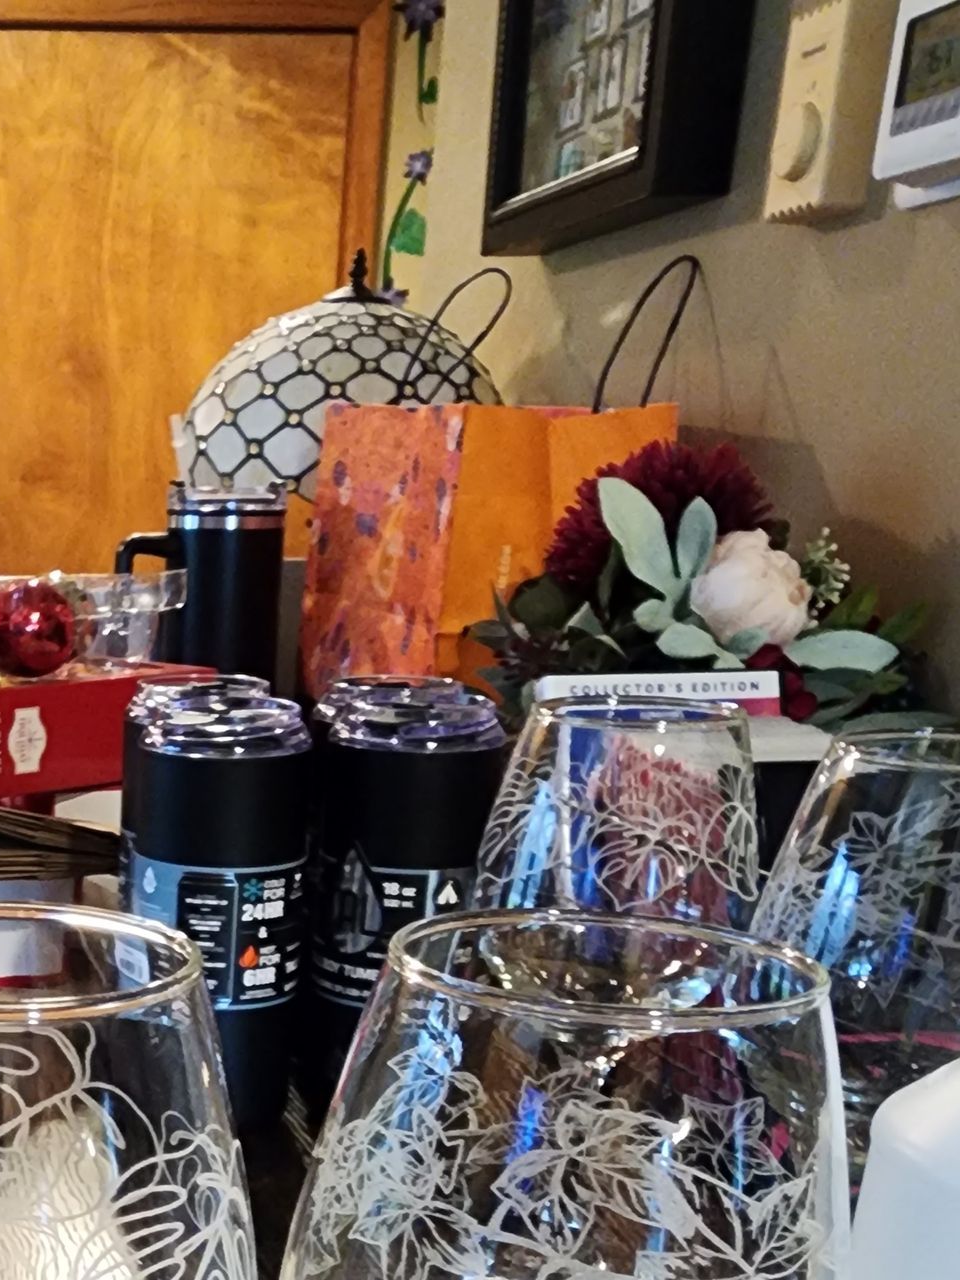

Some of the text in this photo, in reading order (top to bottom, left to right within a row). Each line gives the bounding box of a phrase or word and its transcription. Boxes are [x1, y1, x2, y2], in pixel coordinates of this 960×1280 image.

[569, 681, 760, 697] COLLECTOR'S EDITION
[262, 887, 286, 901] FOR
[259, 953, 281, 967] FOR
